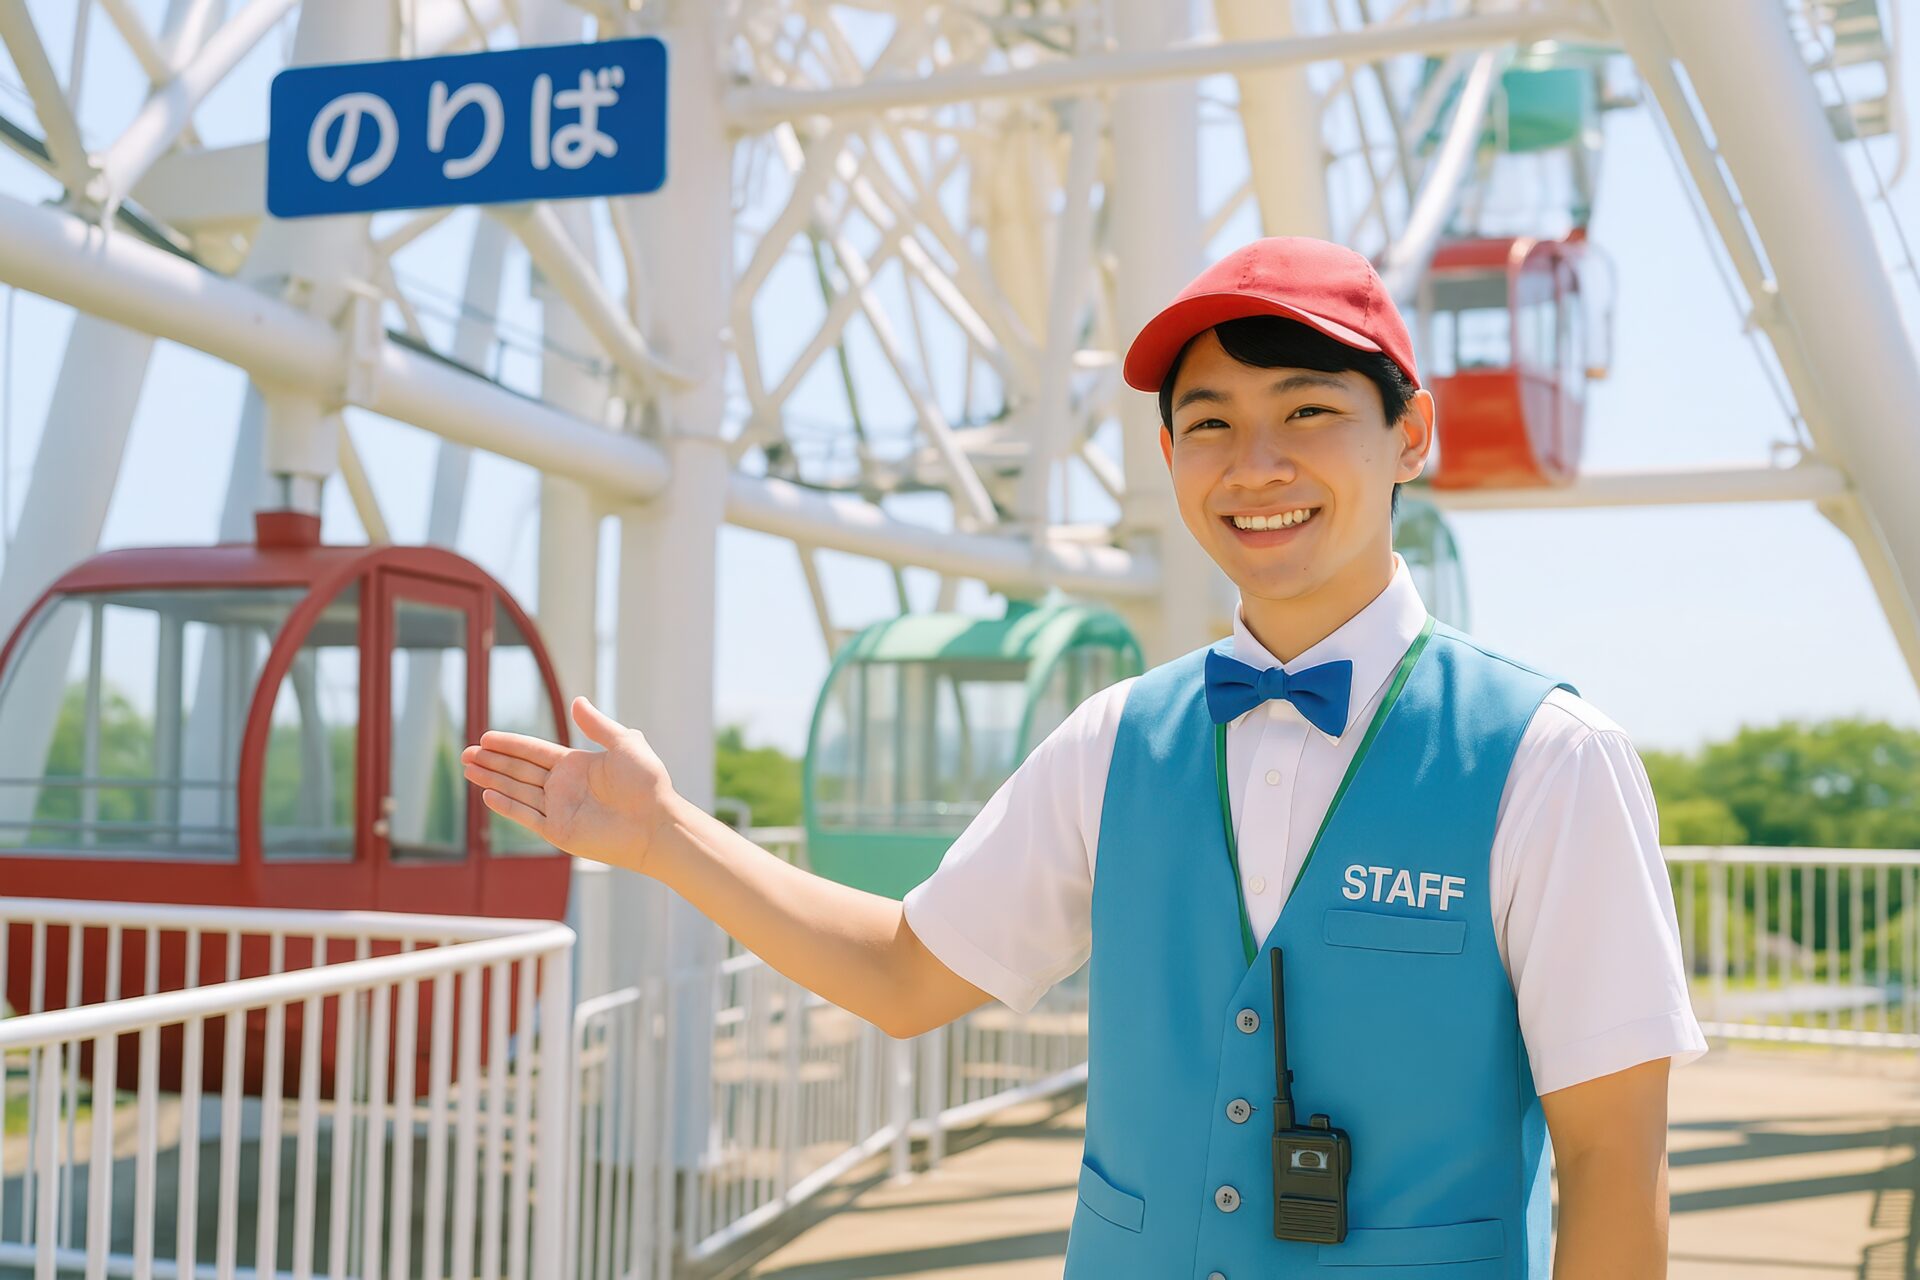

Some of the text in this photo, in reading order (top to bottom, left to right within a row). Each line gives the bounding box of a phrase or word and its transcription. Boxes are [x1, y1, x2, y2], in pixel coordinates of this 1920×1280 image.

[308, 66, 624, 185] のりば
[1342, 864, 1466, 911] STAFF
